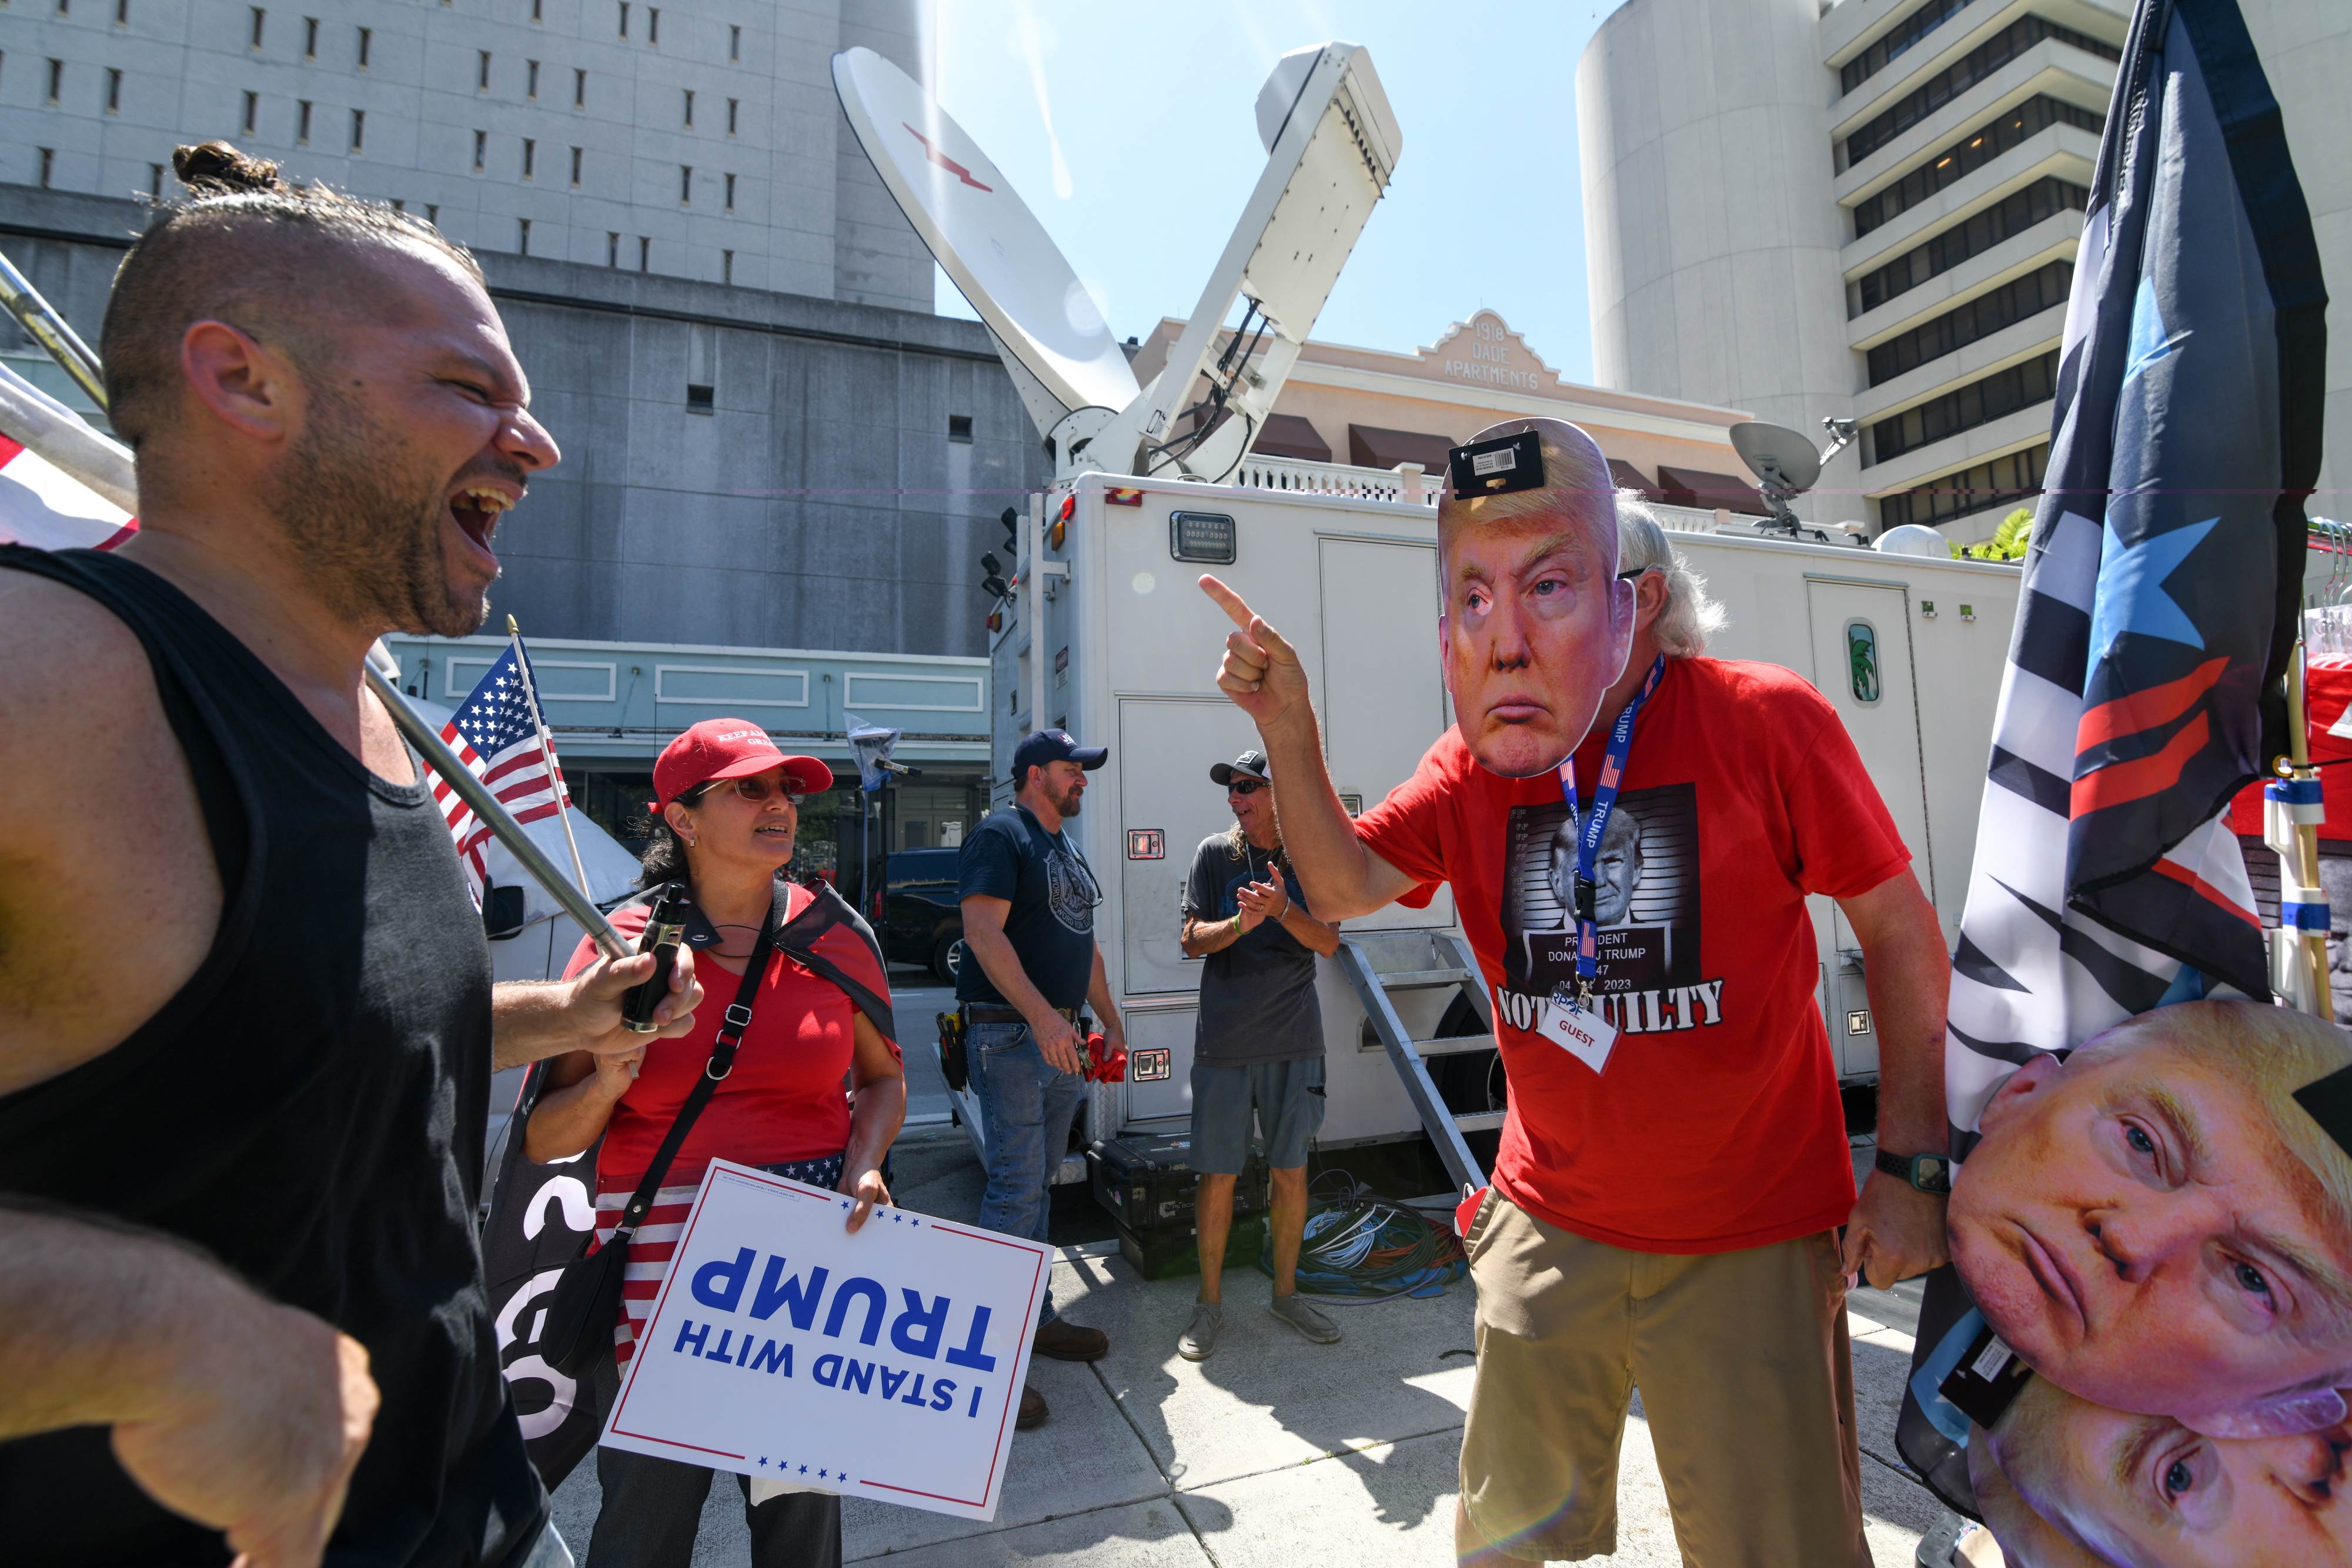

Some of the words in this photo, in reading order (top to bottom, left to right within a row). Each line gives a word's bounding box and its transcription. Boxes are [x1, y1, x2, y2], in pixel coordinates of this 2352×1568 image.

[1475, 322, 1504, 342] 1918
[1472, 342, 1510, 365] DADE
[1444, 359, 1538, 390] APARTMENTS
[717, 730, 748, 741] KEEP
[1615, 699, 1634, 743] TRUMP
[1586, 801, 1608, 848] TRUMP
[1057, 908, 1074, 925] WORD
[1548, 951, 1578, 961] DONA
[1596, 950, 1601, 960] J
[1605, 948, 1646, 960] TRUMP
[1565, 933, 1628, 947] PRDENT
[1559, 981, 1571, 989] 04
[1604, 979, 1631, 990] 2023
[1592, 980, 1723, 1033] UILTY
[1559, 1020, 1595, 1048] GUEST
[691, 1246, 997, 1372] TRUMP
[673, 1319, 793, 1378] WITH
[813, 1353, 957, 1412] STAND
[968, 1386, 983, 1418] I
